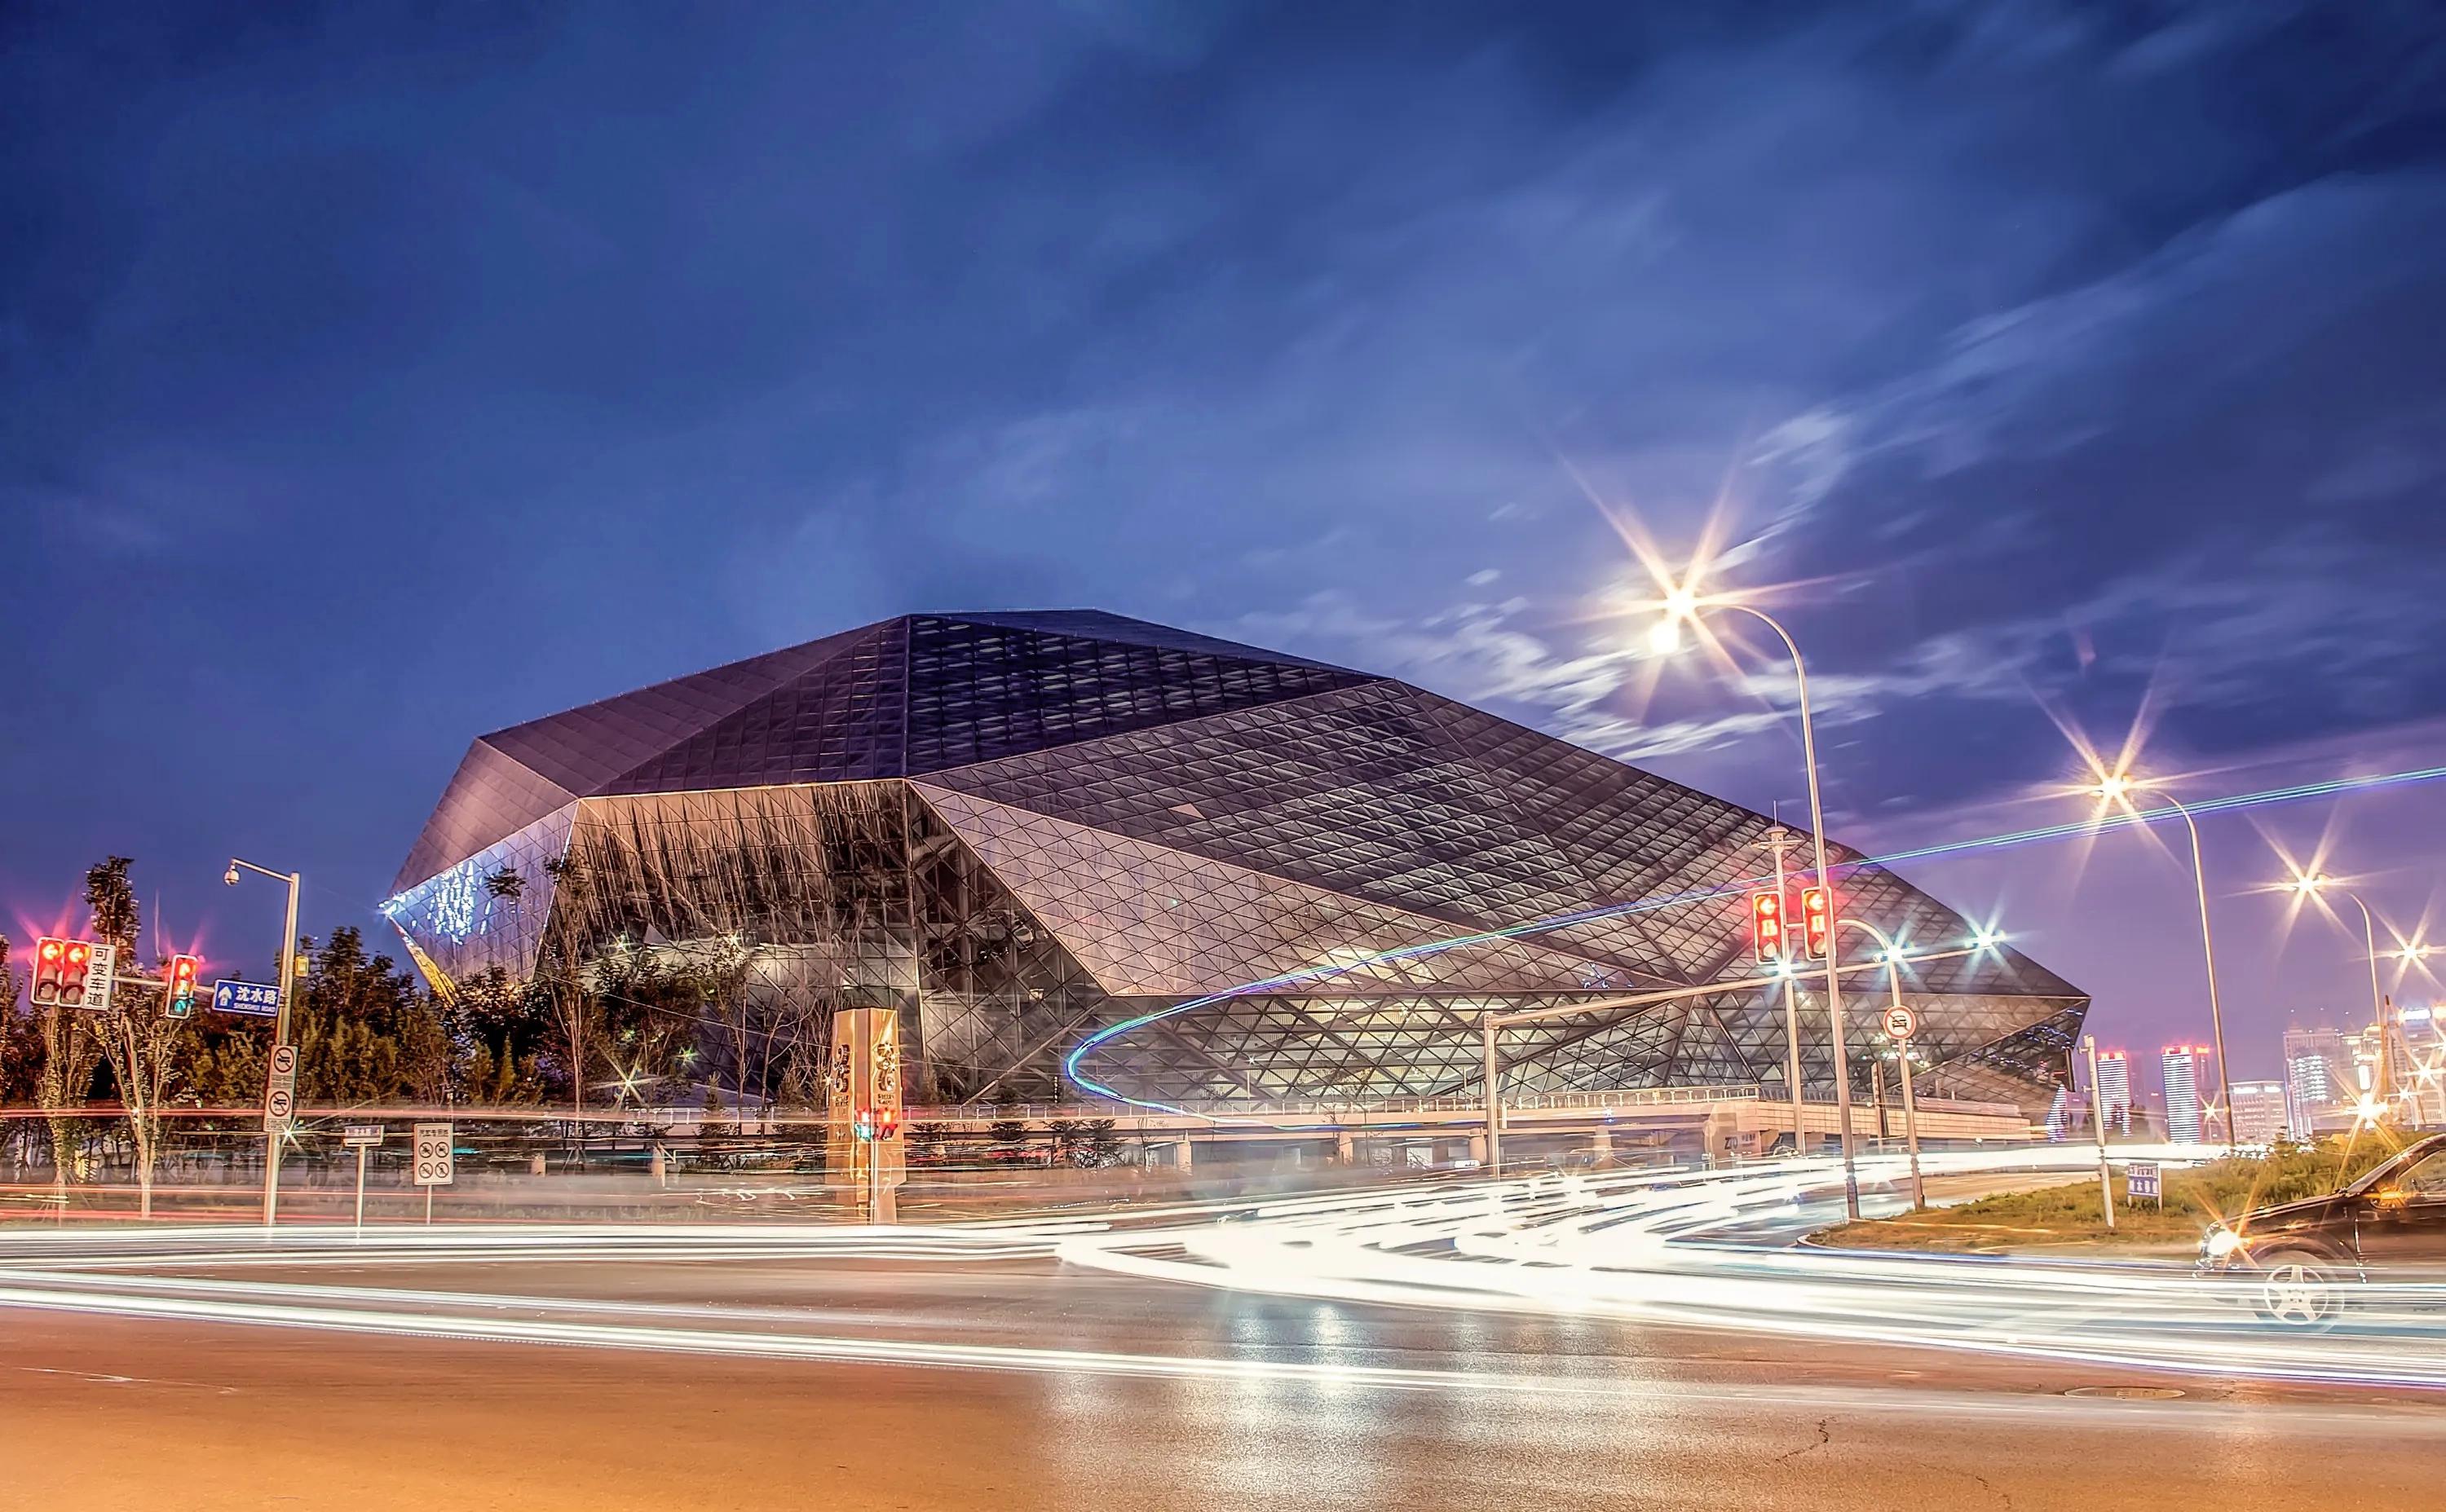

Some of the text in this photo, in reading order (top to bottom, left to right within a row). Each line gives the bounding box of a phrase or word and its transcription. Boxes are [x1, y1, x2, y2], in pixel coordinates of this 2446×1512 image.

[87, 946, 109, 1007] 可变车道
[236, 985, 277, 1005] 沈水路
